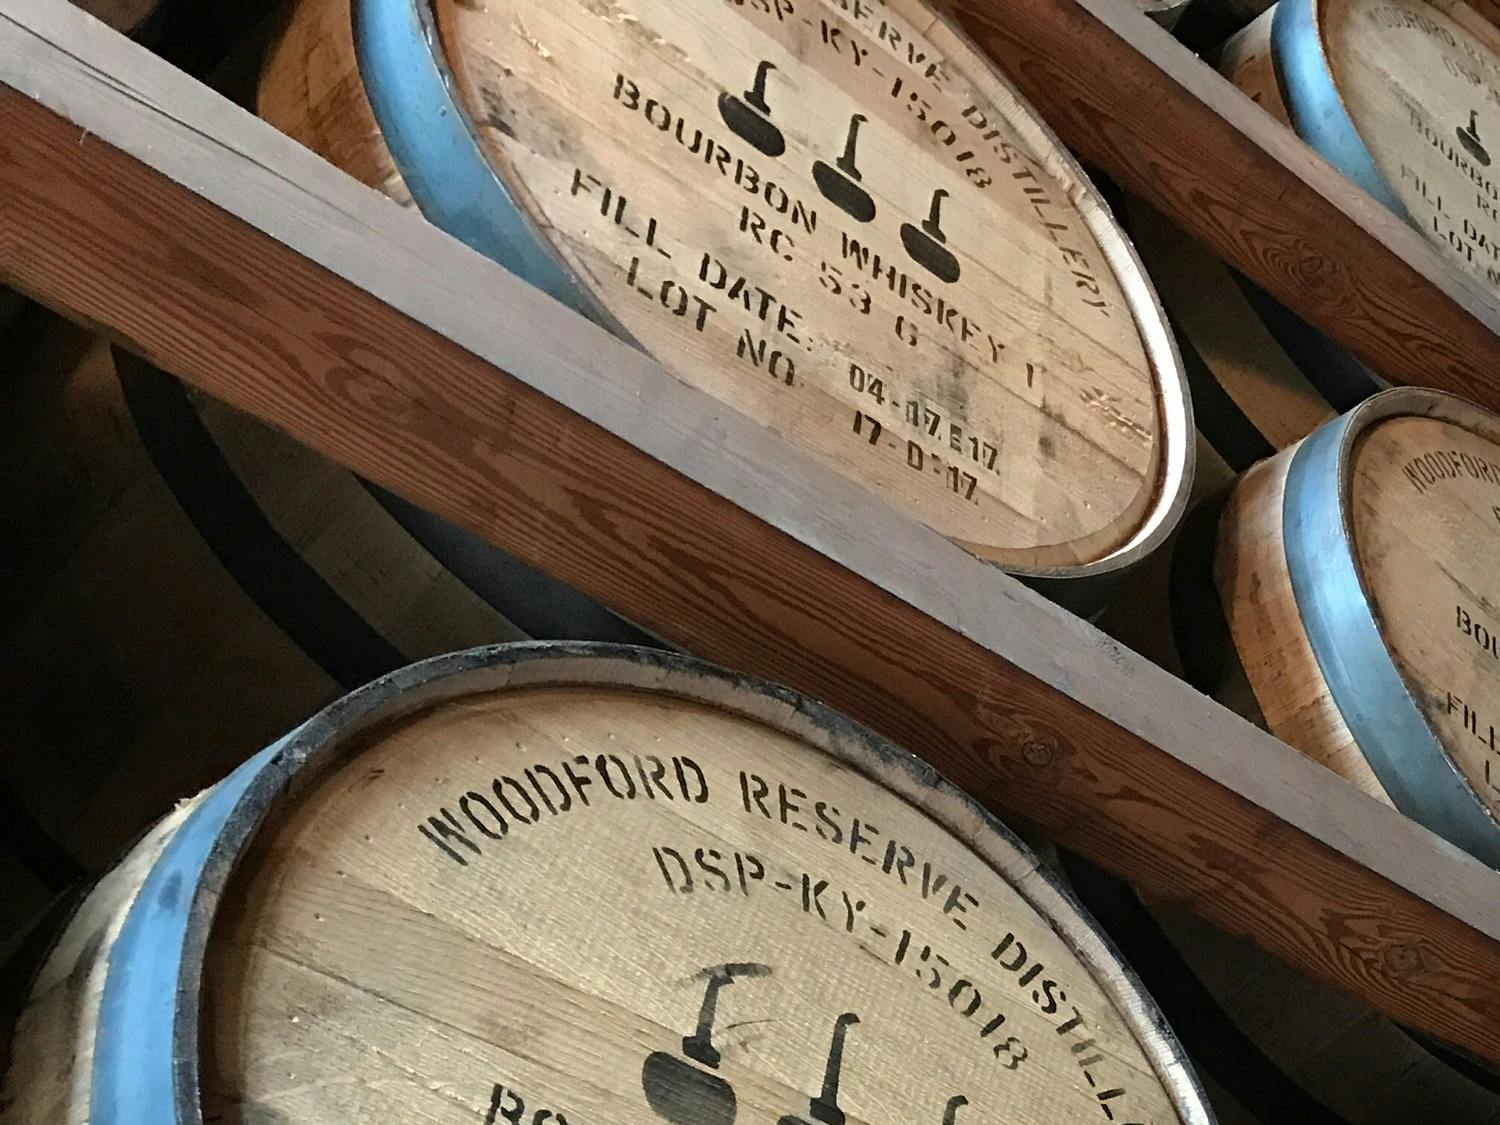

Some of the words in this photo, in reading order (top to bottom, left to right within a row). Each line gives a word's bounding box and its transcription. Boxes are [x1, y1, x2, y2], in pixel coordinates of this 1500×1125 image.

[571, 168, 671, 259] FILL
[613, 73, 816, 234] BOURBON
[841, 232, 1005, 363] WHISKEY
[962, 105, 1110, 317] DISTILLERY
[1400, 163, 1450, 220] FILL
[1433, 215, 1476, 262] LOT
[627, 257, 707, 332] LOT
[818, 261, 872, 315] 53
[418, 753, 709, 867] WOODFORD
[739, 770, 980, 931] RESERVE
[652, 845, 1029, 1071] DSP-KY-15018
